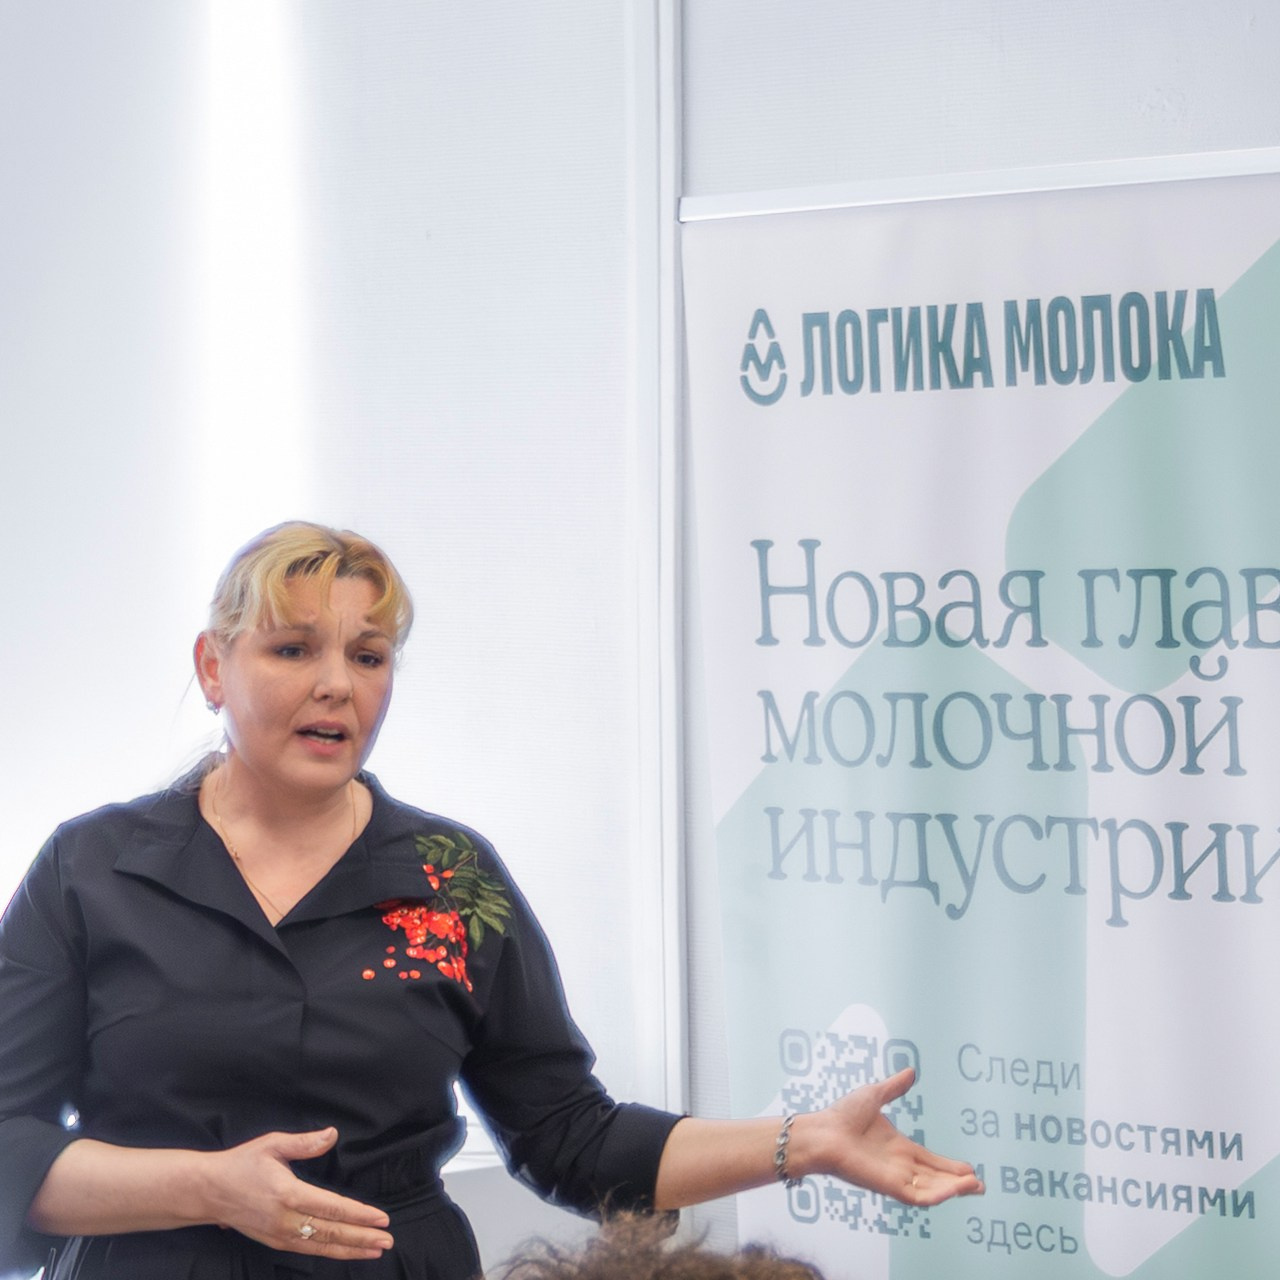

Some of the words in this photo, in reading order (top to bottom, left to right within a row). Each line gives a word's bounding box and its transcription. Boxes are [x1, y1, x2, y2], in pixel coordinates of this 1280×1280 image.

[800, 302, 995, 397] ЛОГИКА
[1003, 287, 1227, 388] МОЛОКА
[750, 538, 1050, 650] Новая
[757, 654, 1248, 777] молочной
[957, 1043, 1081, 1092] Следи
[960, 1108, 1000, 1138] за
[1013, 1111, 1245, 1162] новостями
[1000, 1164, 1257, 1221] вакансиями
[966, 1216, 1080, 1256] здесь
